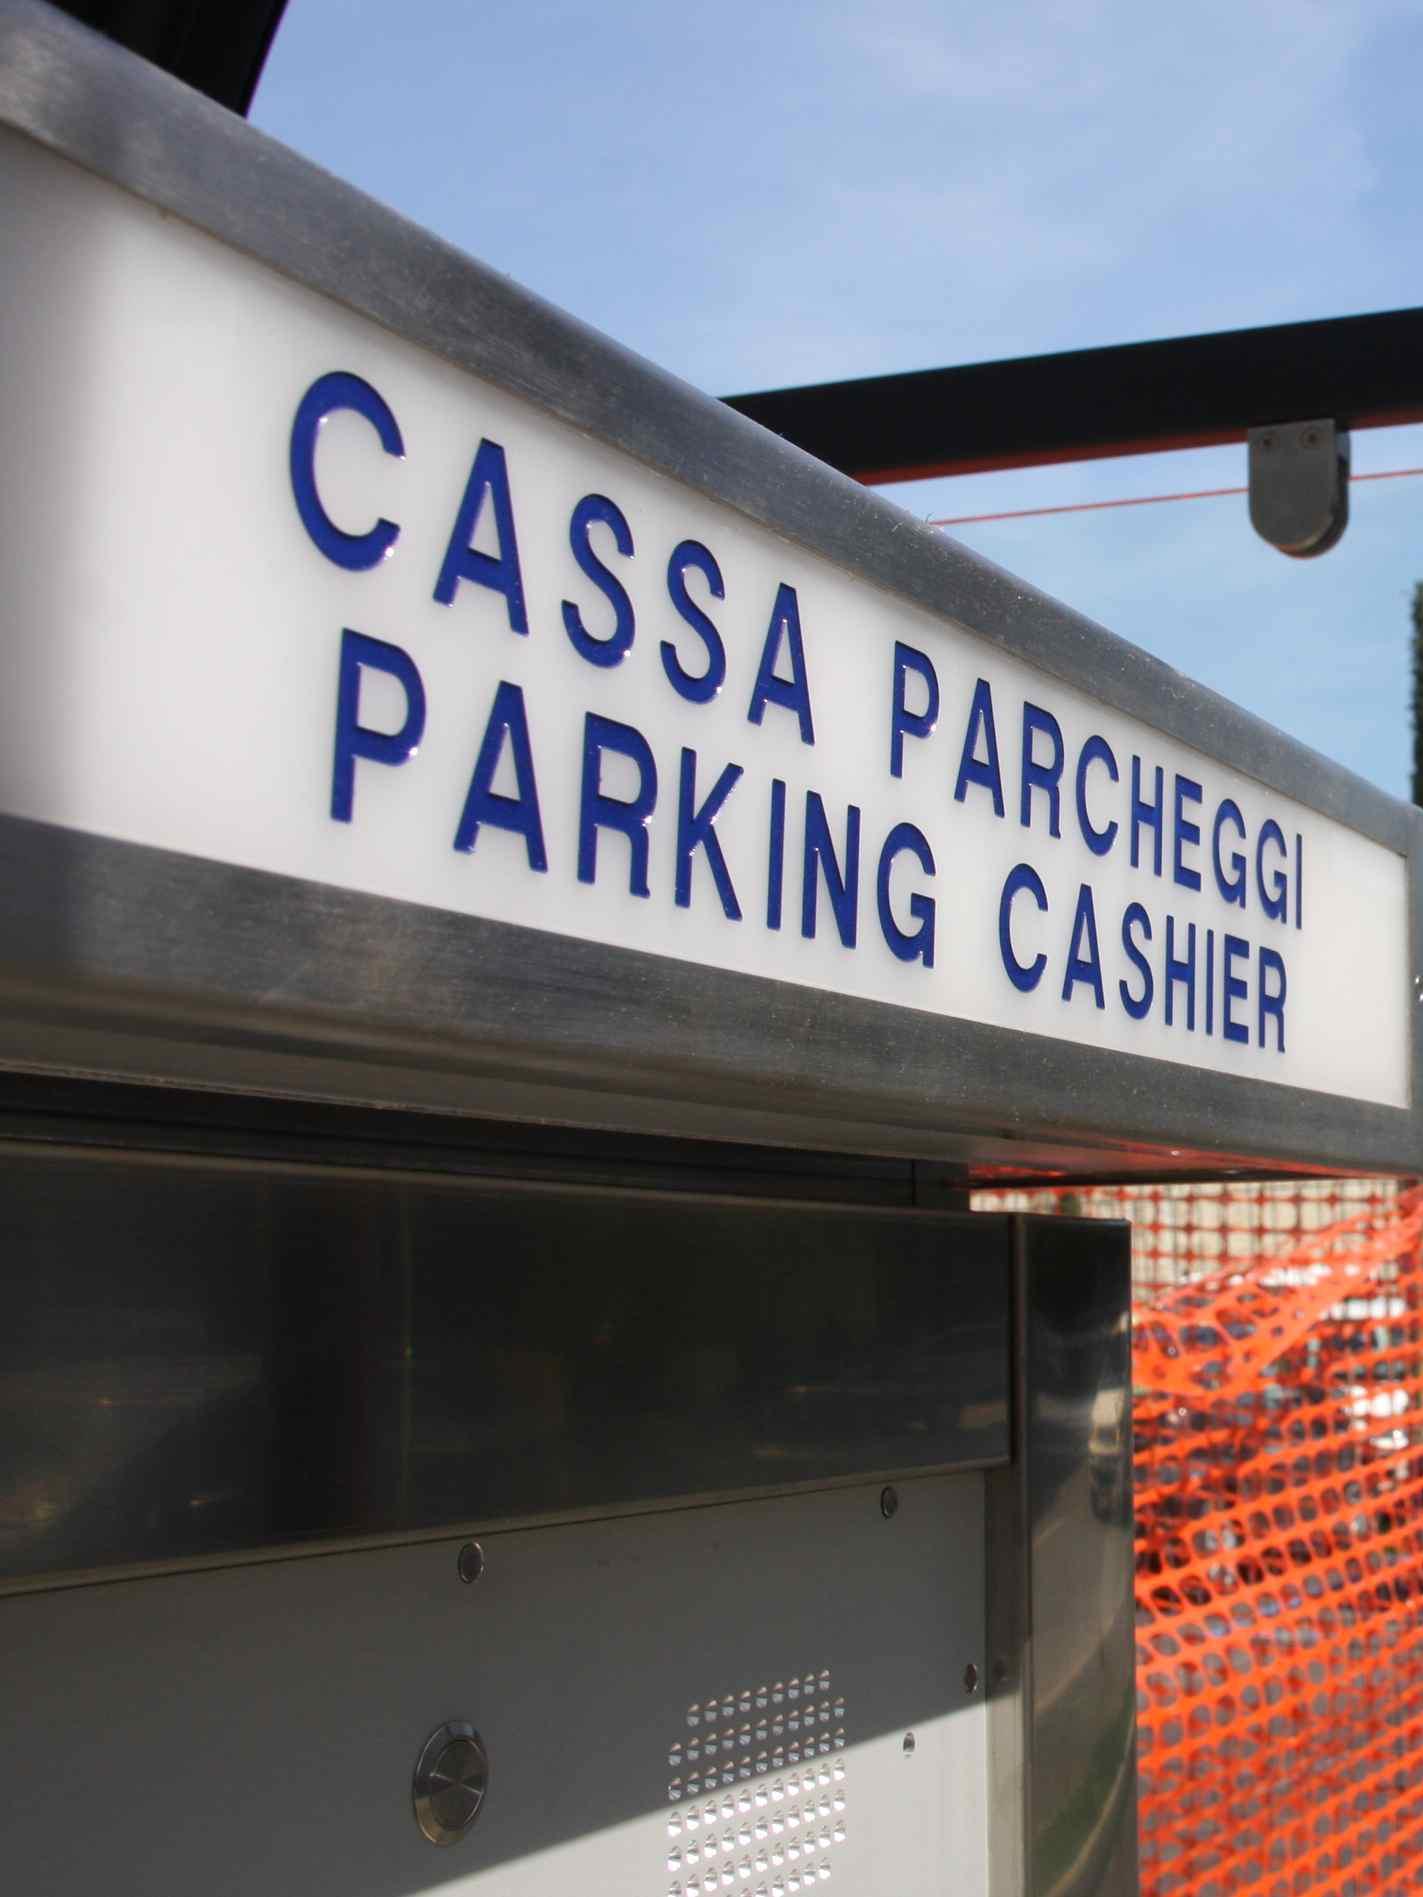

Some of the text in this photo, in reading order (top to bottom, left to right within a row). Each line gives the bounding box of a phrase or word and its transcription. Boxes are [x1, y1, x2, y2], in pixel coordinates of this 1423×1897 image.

[289, 370, 1303, 930] CASSA PARCHEGGI
[330, 629, 1287, 1053] PARKING CASHIER
